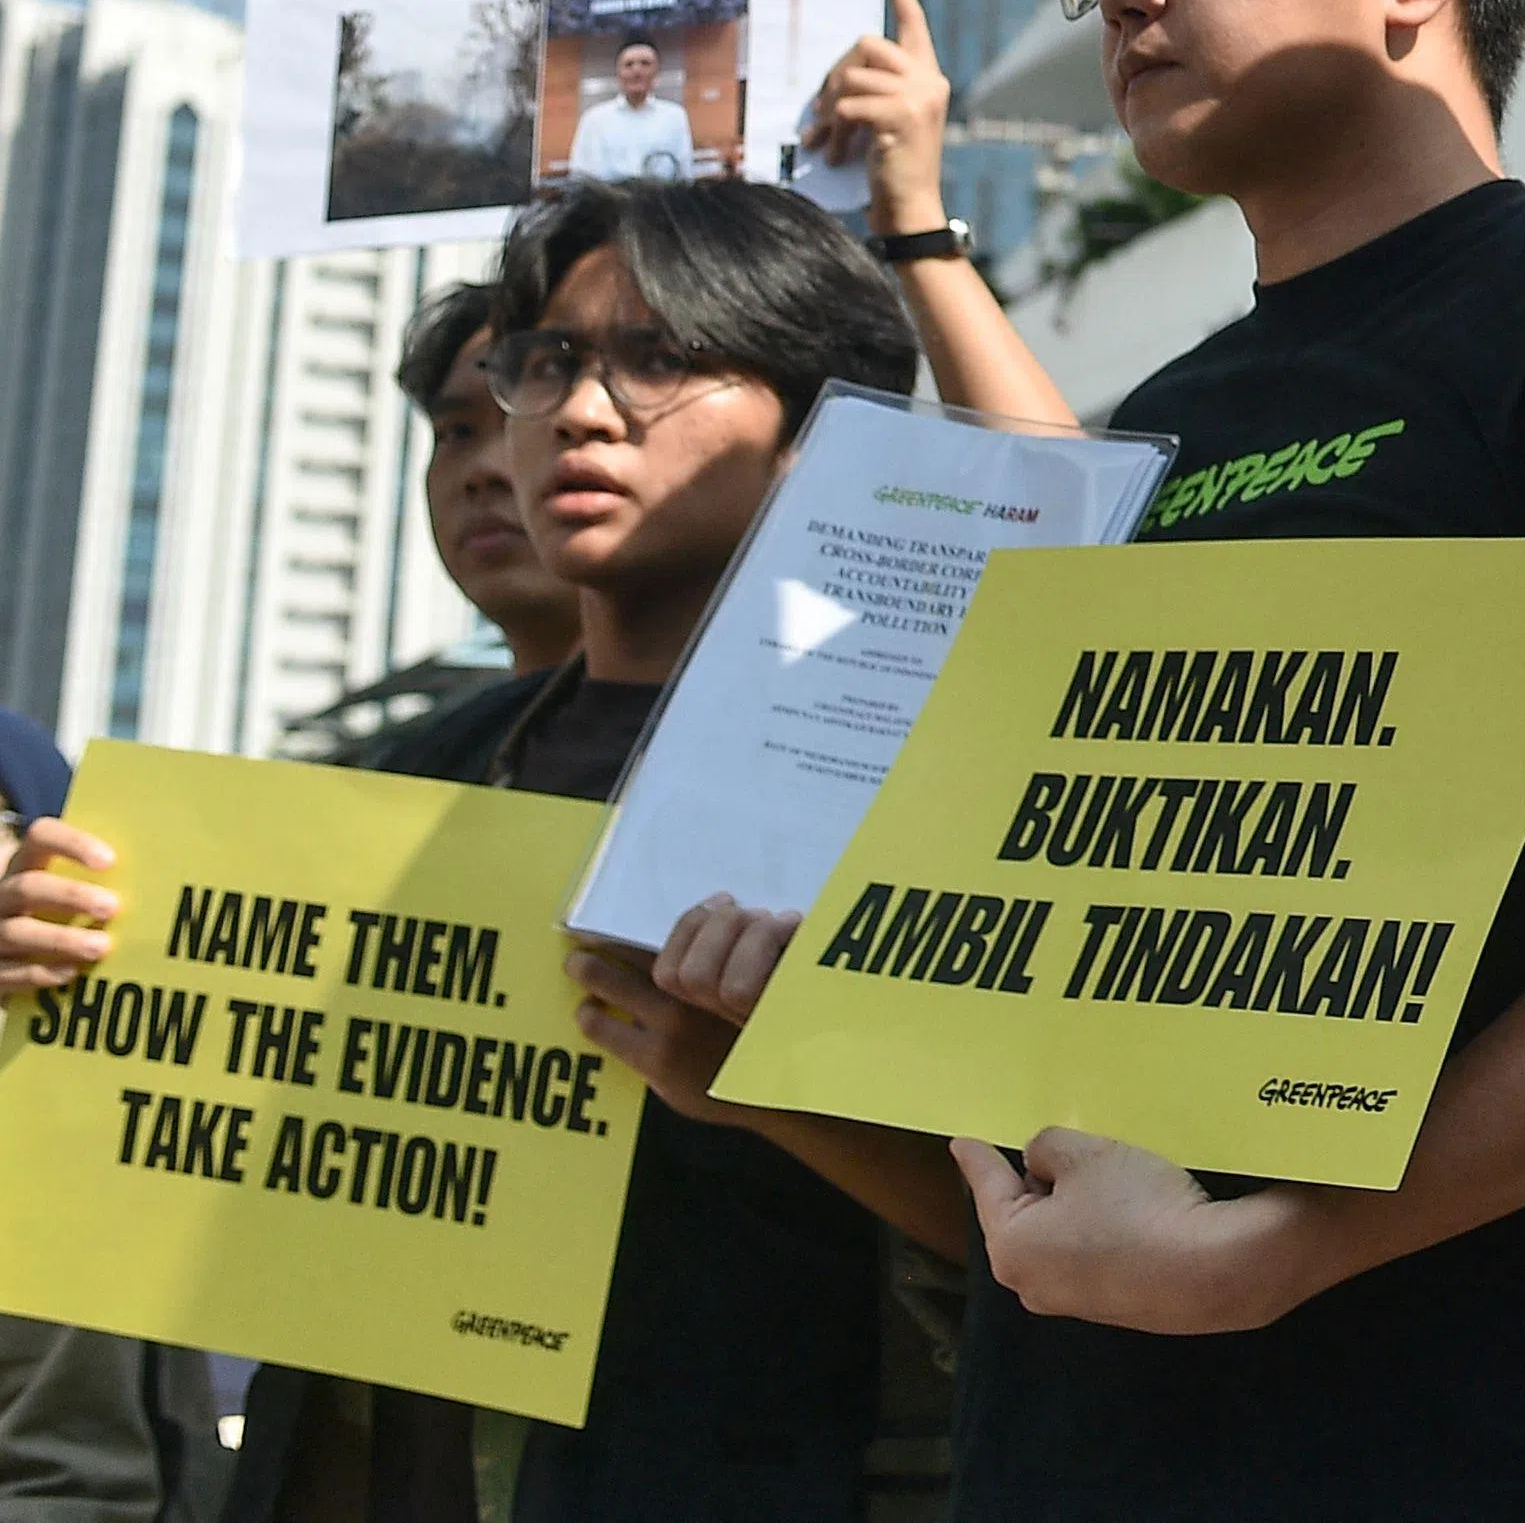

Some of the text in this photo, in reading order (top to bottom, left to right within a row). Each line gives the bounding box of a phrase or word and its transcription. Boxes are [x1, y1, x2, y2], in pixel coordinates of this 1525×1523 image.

[982, 501, 1040, 523] HARAM
[806, 519, 906, 552] DEMANDING
[819, 543, 941, 576] CROSS-BORDER
[823, 582, 954, 619] TRANSBOUNDARY
[838, 567, 967, 600] ACCOUNTABILITY
[861, 610, 949, 636] POLLUTION
[1050, 650, 1399, 746] NAMAKAN.
[997, 773, 1357, 879] BUKTIKAN.
[168, 885, 507, 1008] NAME THEM.
[817, 882, 1455, 1024] AMBIL TINDAKAN!
[29, 974, 608, 1137] SHOW THE EVIDENCE.
[1257, 1078, 1399, 1113] GREENPEACE
[118, 1089, 498, 1227] TAKE ACTION!
[452, 1310, 571, 1353] GREENPEACE
